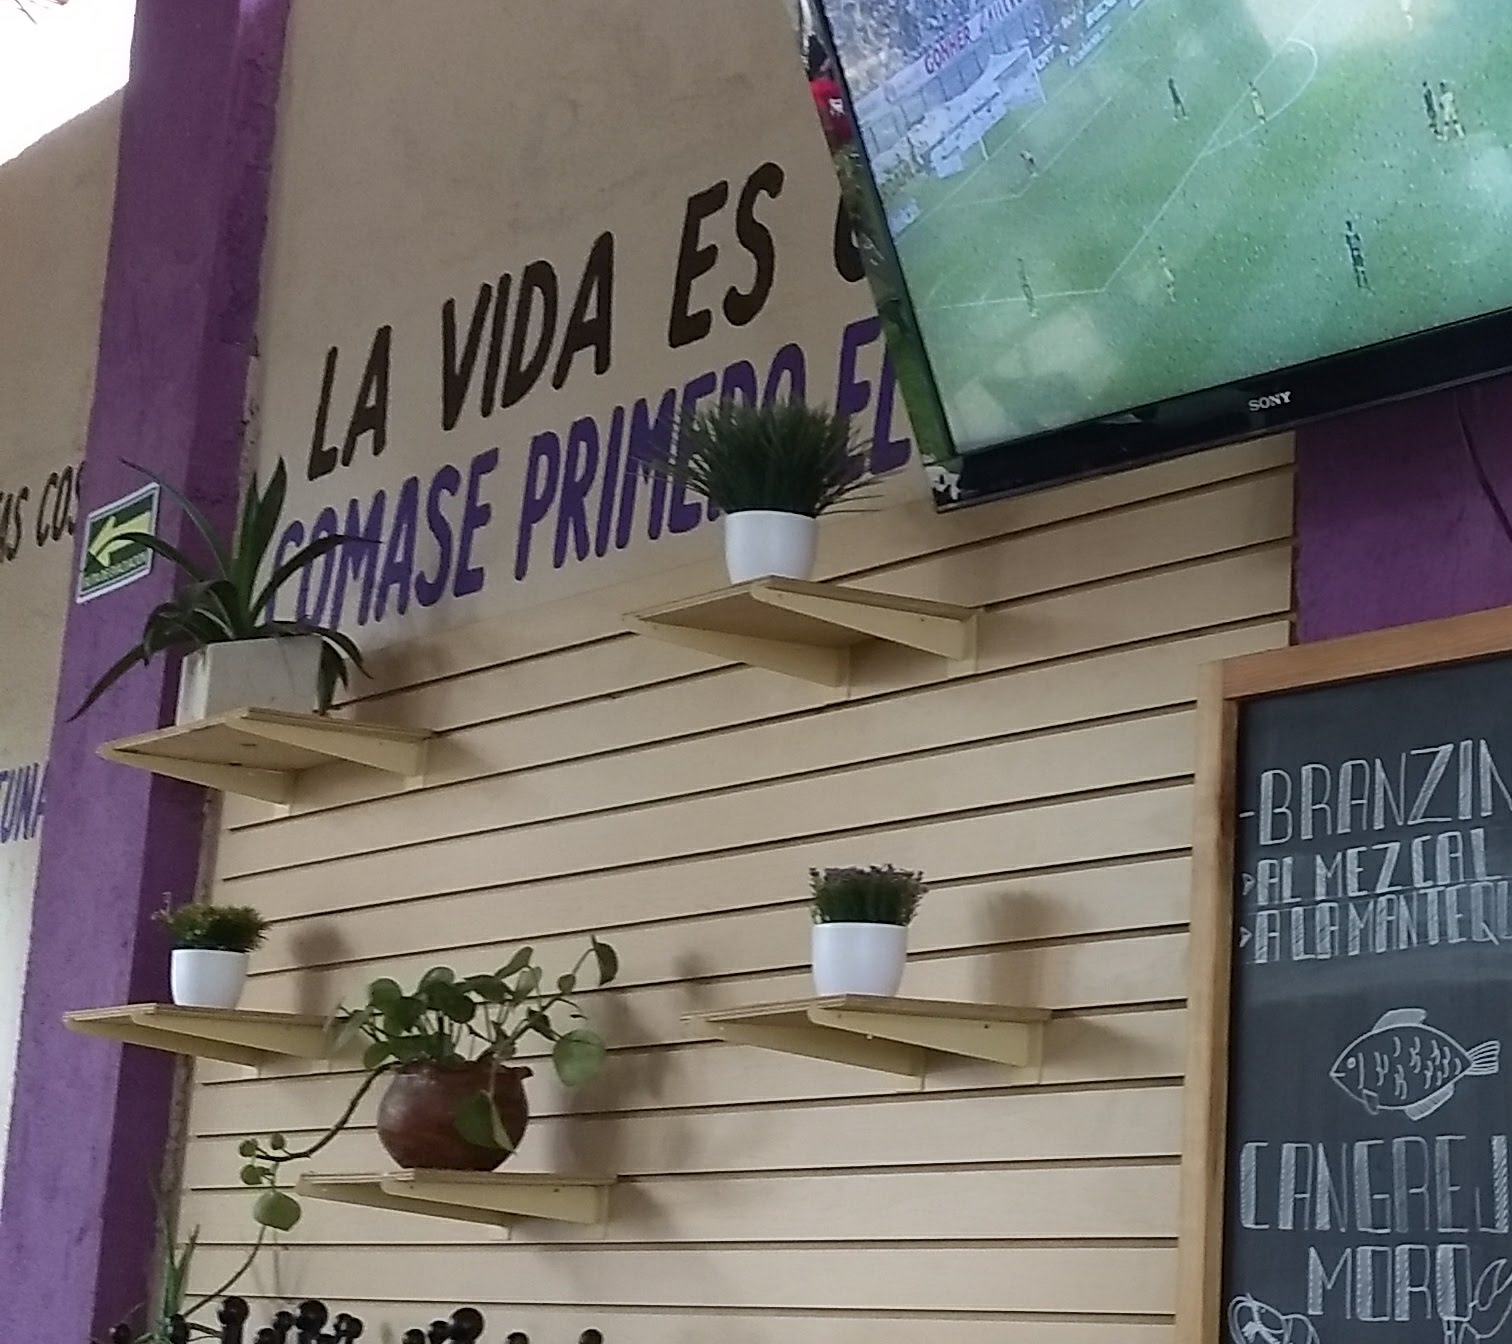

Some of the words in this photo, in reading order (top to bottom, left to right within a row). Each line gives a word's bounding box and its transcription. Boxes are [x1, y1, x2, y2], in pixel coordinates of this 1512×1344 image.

[307, 323, 392, 481] LA
[441, 230, 614, 431] VIDA
[668, 162, 785, 349] ES
[1248, 391, 1291, 412] SONY
[266, 447, 499, 624] COMASE
[1314, 827, 1502, 902] MEZCAL
[1307, 1243, 1472, 1322] MORO
